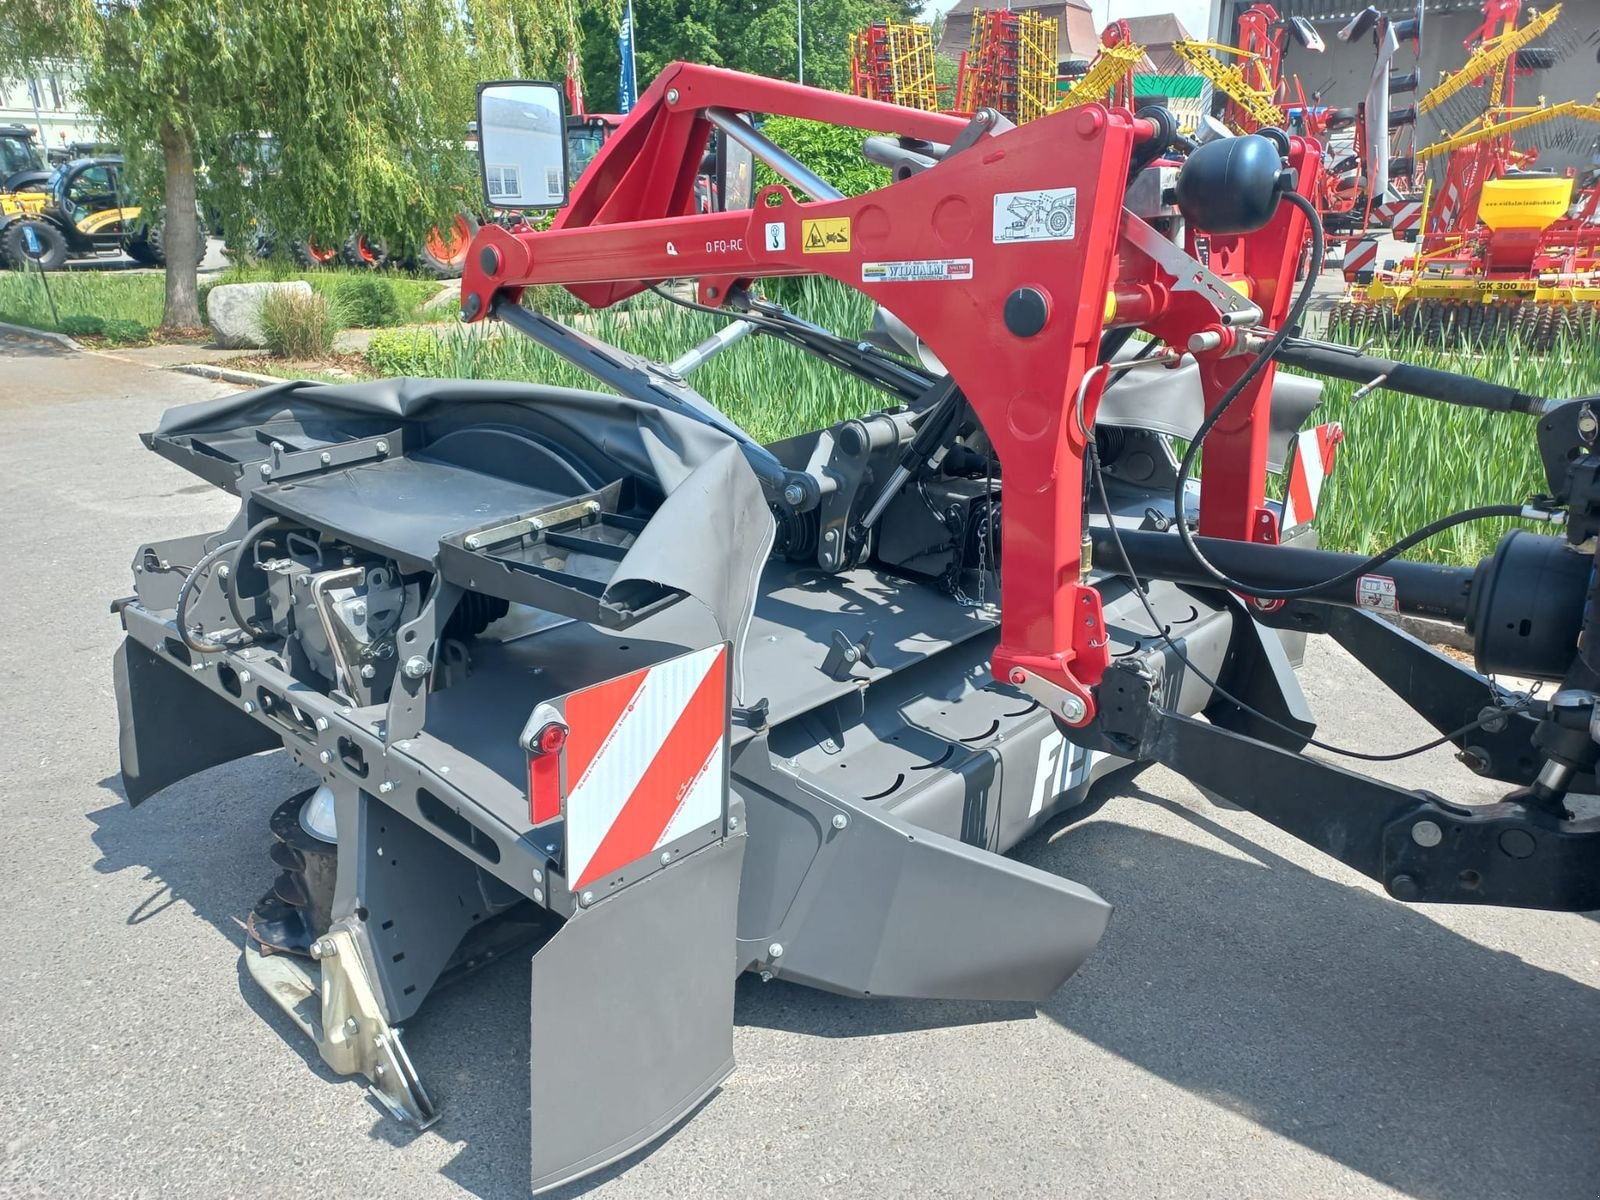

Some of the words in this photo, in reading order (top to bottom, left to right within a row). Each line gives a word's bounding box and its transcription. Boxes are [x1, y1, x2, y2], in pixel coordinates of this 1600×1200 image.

[713, 239, 743, 254] FQ-RC
[888, 264, 944, 277] WIDHALM
[1479, 282, 1493, 290] GK
[1496, 282, 1518, 290] 300
